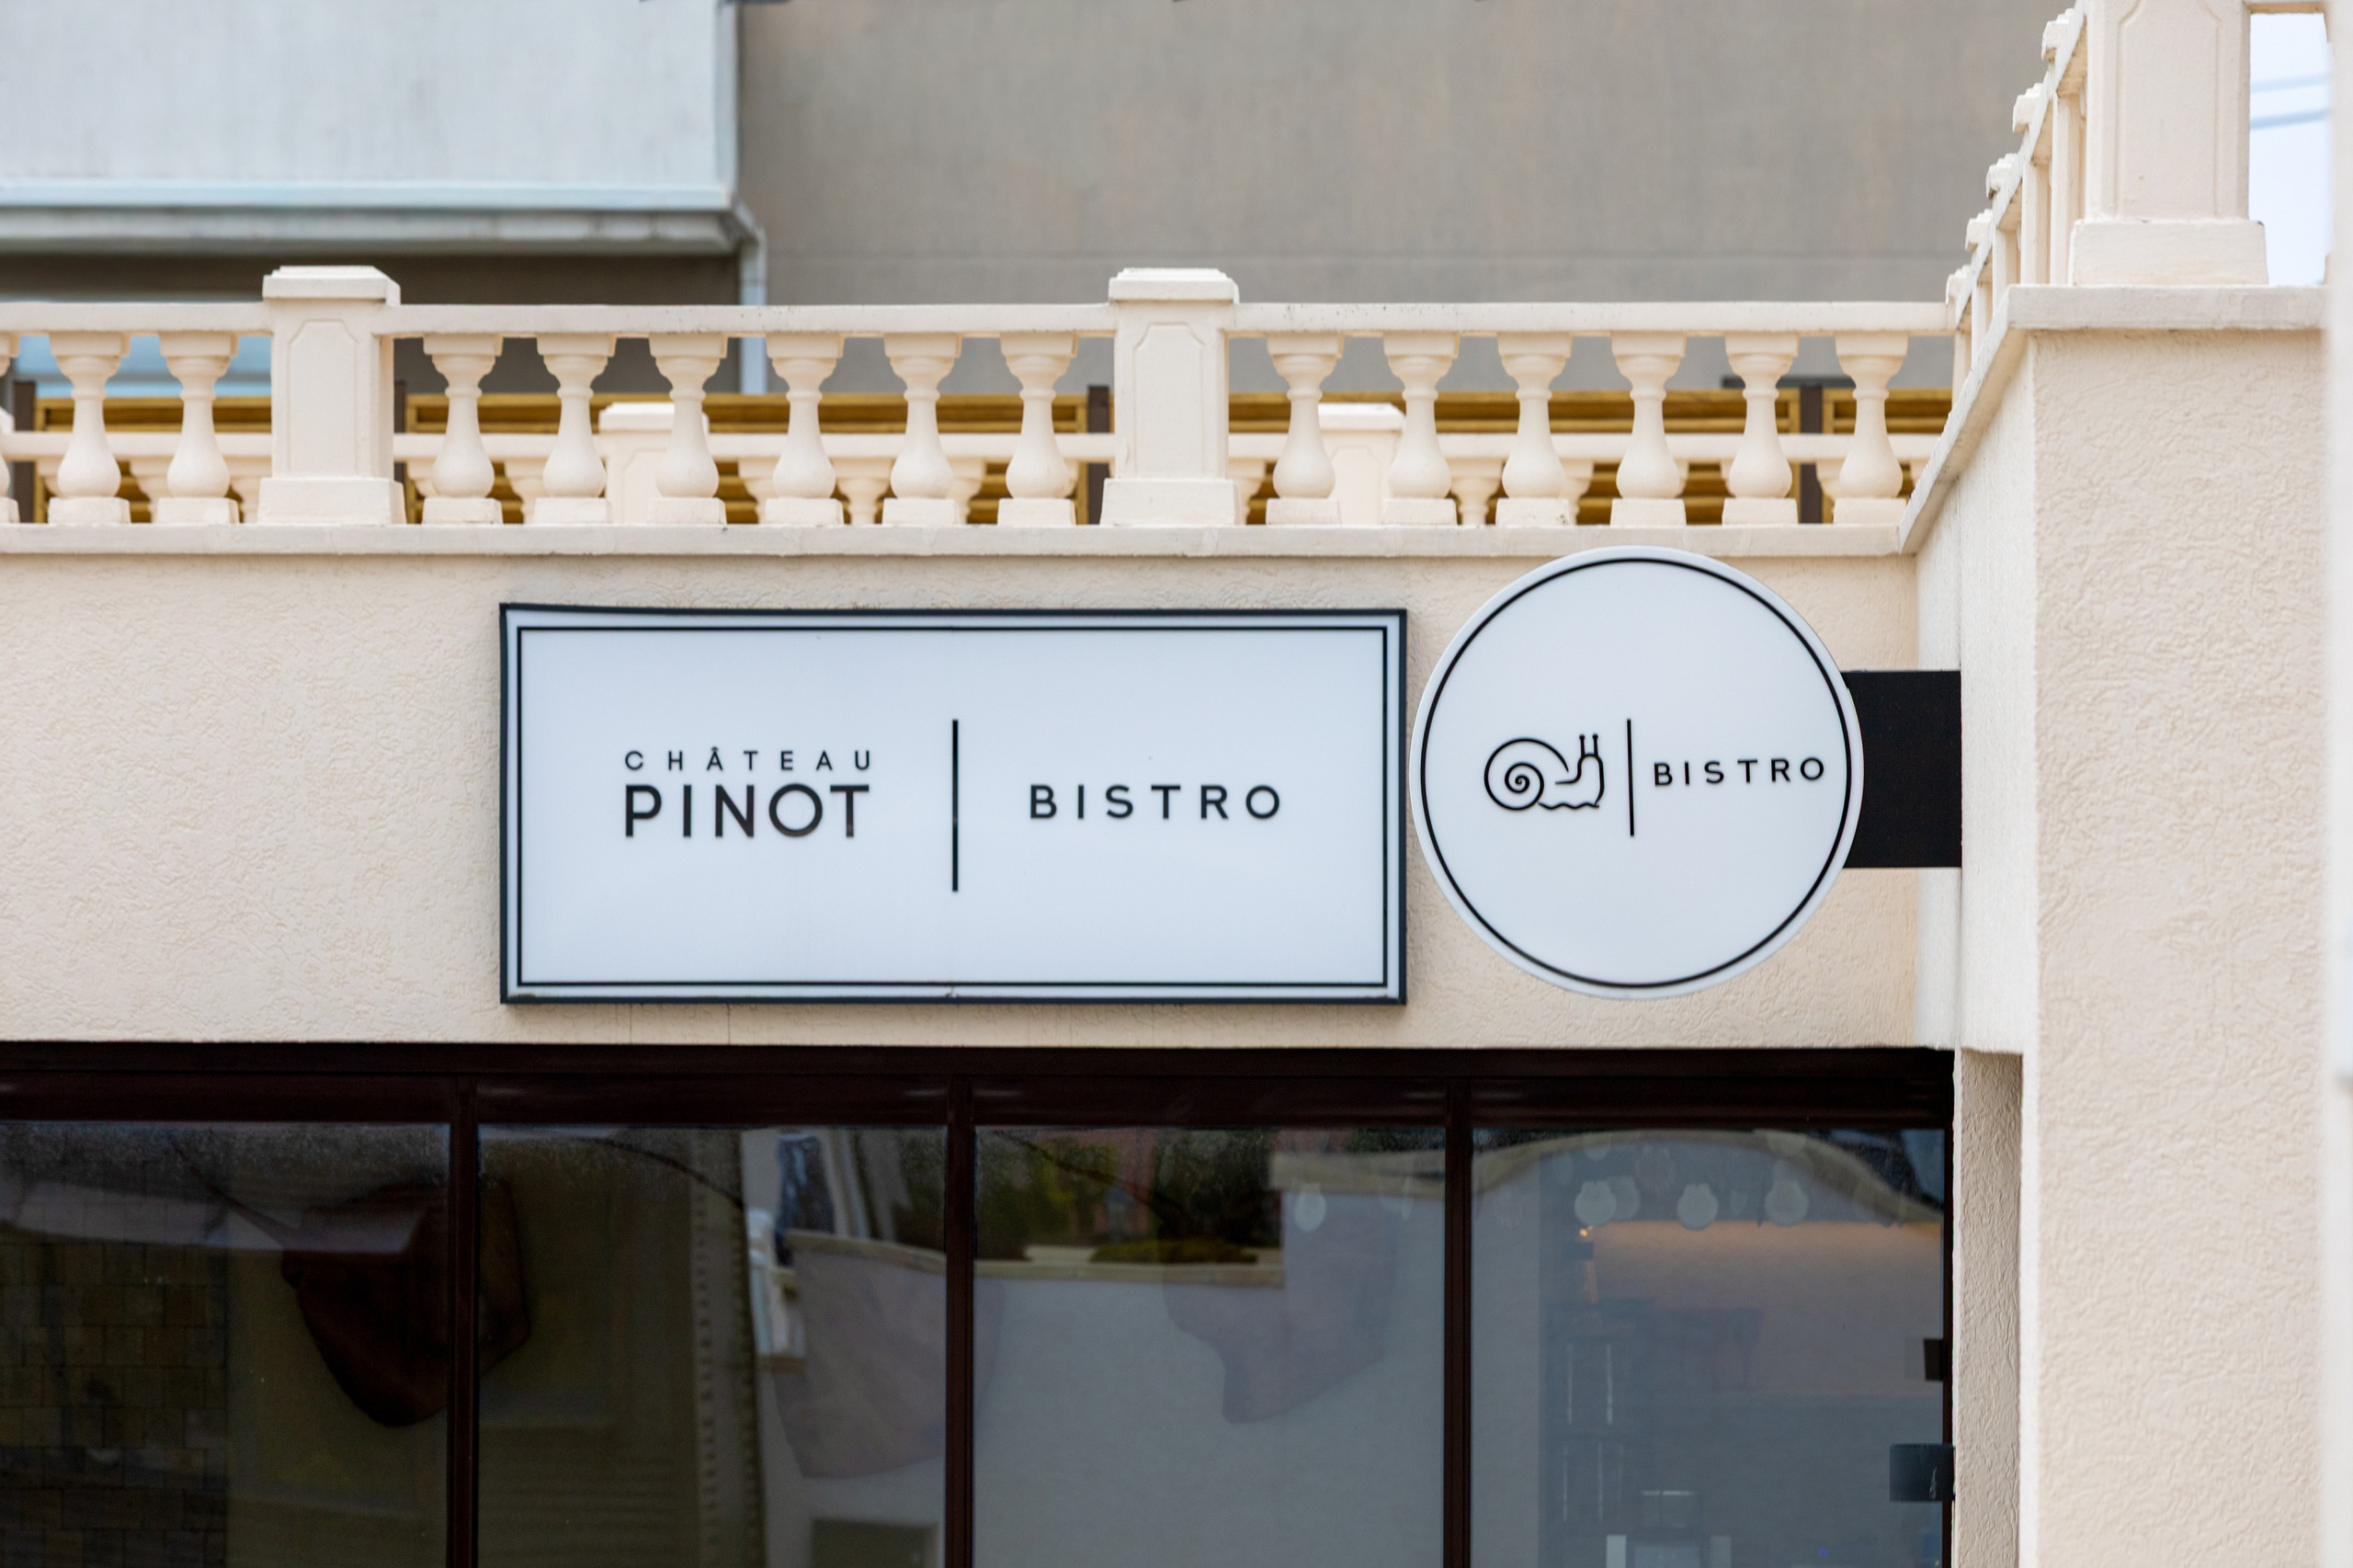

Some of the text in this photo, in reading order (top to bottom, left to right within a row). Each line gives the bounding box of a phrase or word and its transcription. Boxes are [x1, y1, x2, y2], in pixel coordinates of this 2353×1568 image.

[624, 746, 870, 771] CHÂTEAU
[1654, 756, 1824, 787] BISTRO
[625, 784, 870, 838] PINOT
[1029, 784, 1280, 820] BISTRO
